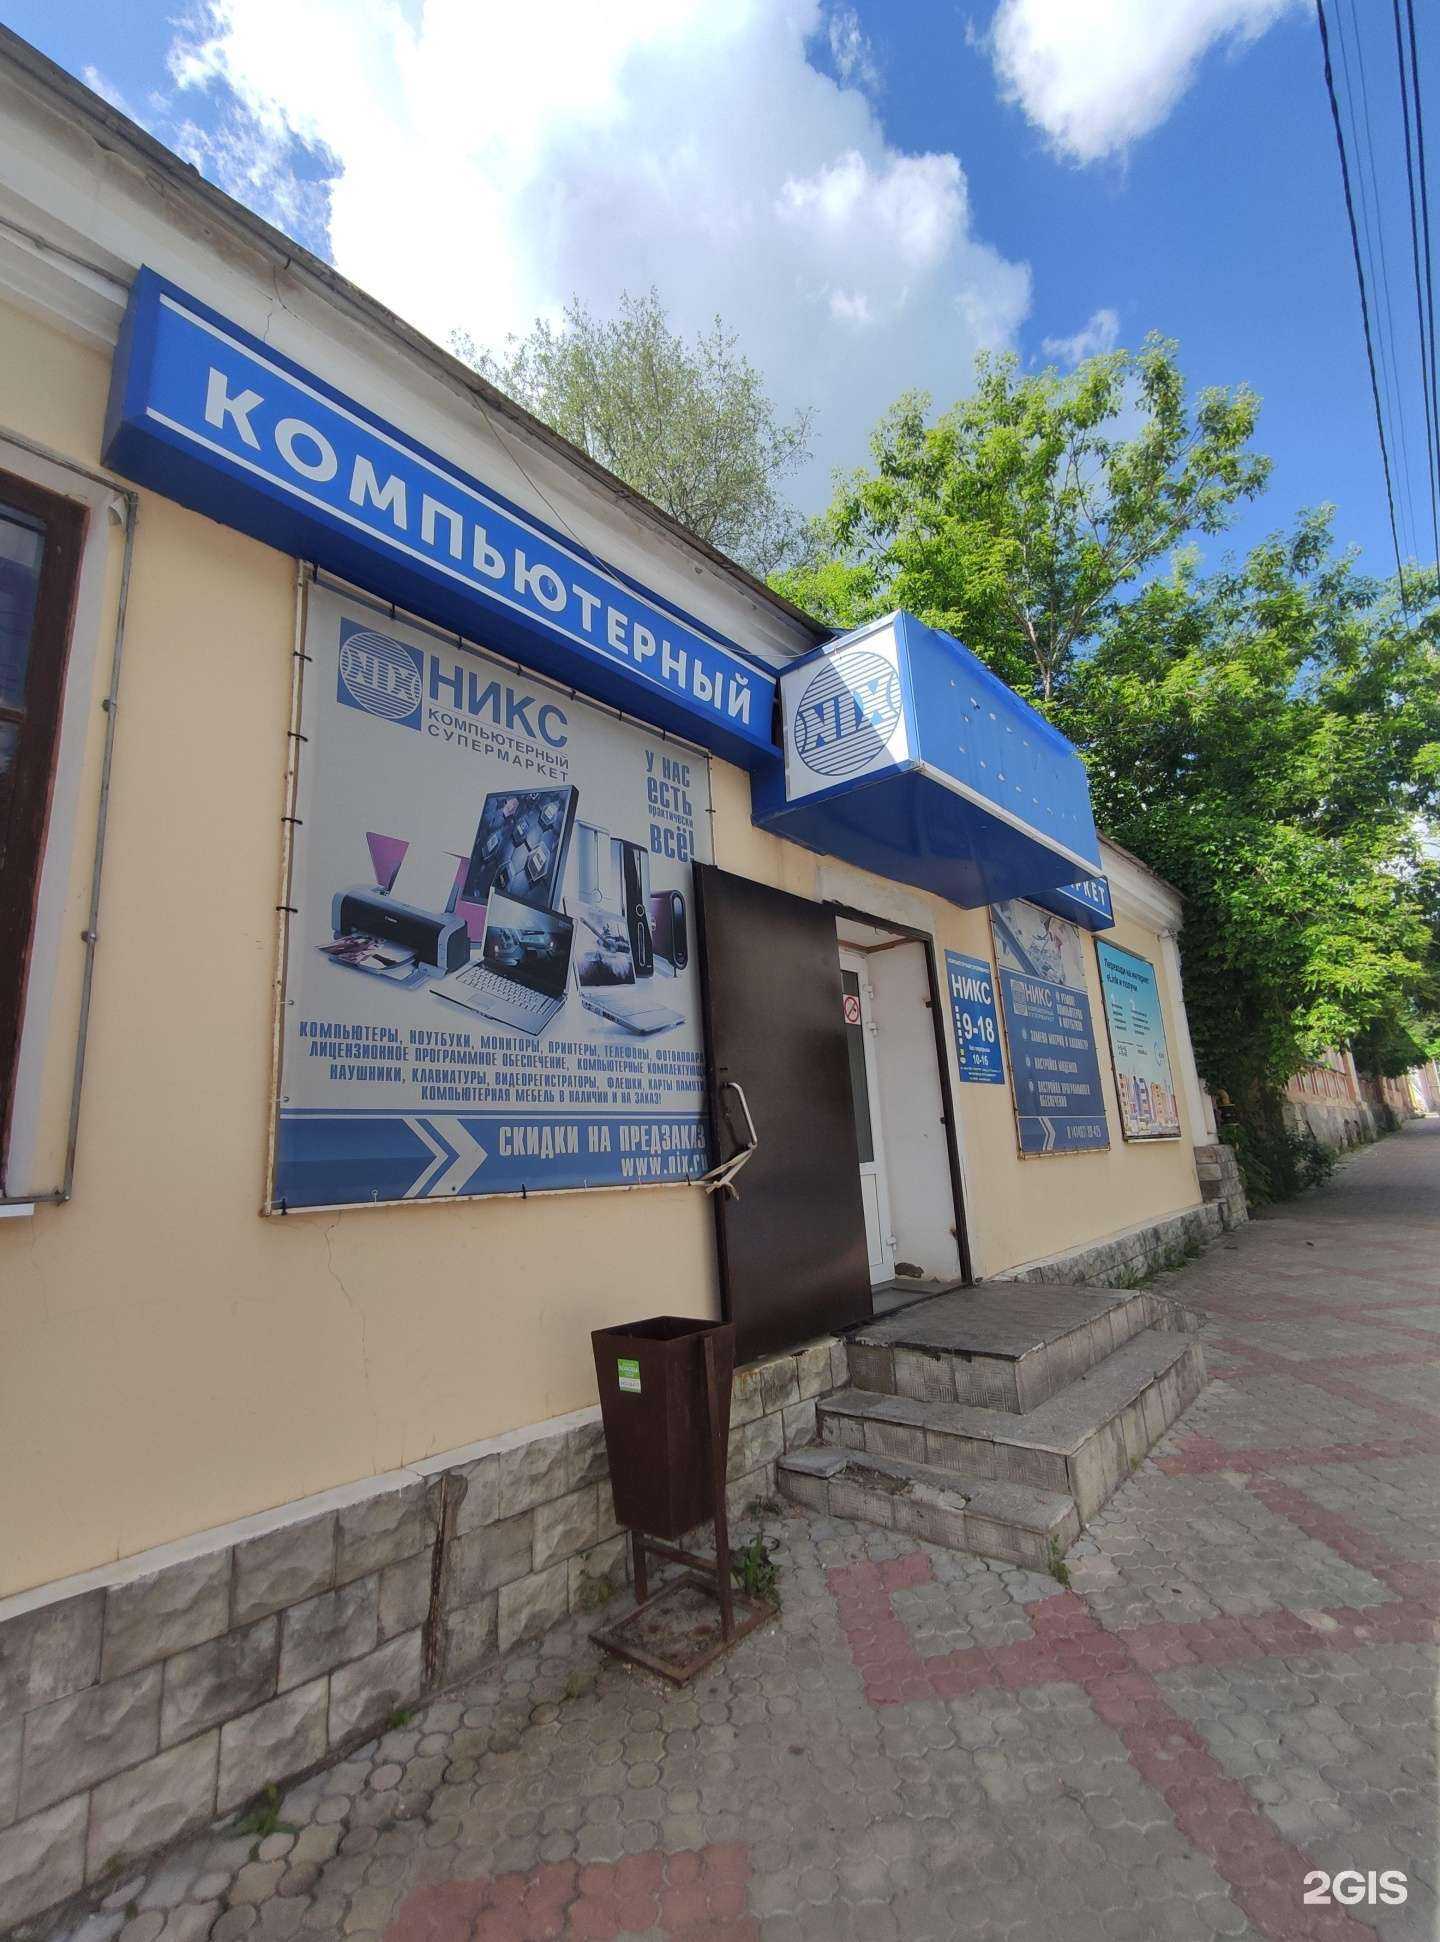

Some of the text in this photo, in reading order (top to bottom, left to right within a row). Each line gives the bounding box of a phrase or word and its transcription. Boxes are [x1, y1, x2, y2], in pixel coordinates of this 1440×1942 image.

[203, 365, 753, 725] КОМПЬЮТЕРНЫЙ
[429, 655, 568, 748] НИКС
[428, 707, 569, 769] КОМПЬЮТЕРНЫЙ
[428, 723, 568, 782] СУПЕРМАРКЕТ
[645, 750, 690, 788] У НАС
[951, 973, 991, 1005] НИКС
[1024, 983, 1052, 1008] НИКС
[299, 1021, 704, 1064] КОМПЬЮТЕРЫ, НОУТБУКИ, МОНИТОРЫ, ПРИНТЕРЫ, ТЕЛЕФОНЫ, ФОТОАППАРА
[962, 1012, 995, 1043] 9-18
[309, 1041, 409, 1062] ЛИЦЕНЗИОННОЕ
[415, 1047, 497, 1066] ПРОГРАММНОЕ
[502, 1053, 569, 1071] ОБЕСПЕЧЕНИЕ,
[577, 1057, 644, 1073] КОМПЬЮТЕРНЫЕ
[330, 1064, 406, 1084] НАУШНИКИ,
[412, 1068, 490, 1087] КЛАВИАТУРЫ,
[495, 1071, 599, 1090] ВИДЕОРЕГИСТРАТОРЫ,
[607, 1076, 645, 1092] ФЛЕШКИ,
[648, 1078, 673, 1091] КАРТЫ
[421, 1086, 662, 1105] КОМПЬЮТЕРНАЯ МЕБЕЛЬ В НАЛИЧИИ И НА ЗАКАЗ!
[499, 1124, 706, 1159] СКИДКИ НА ПРЕДЗАКАЗ
